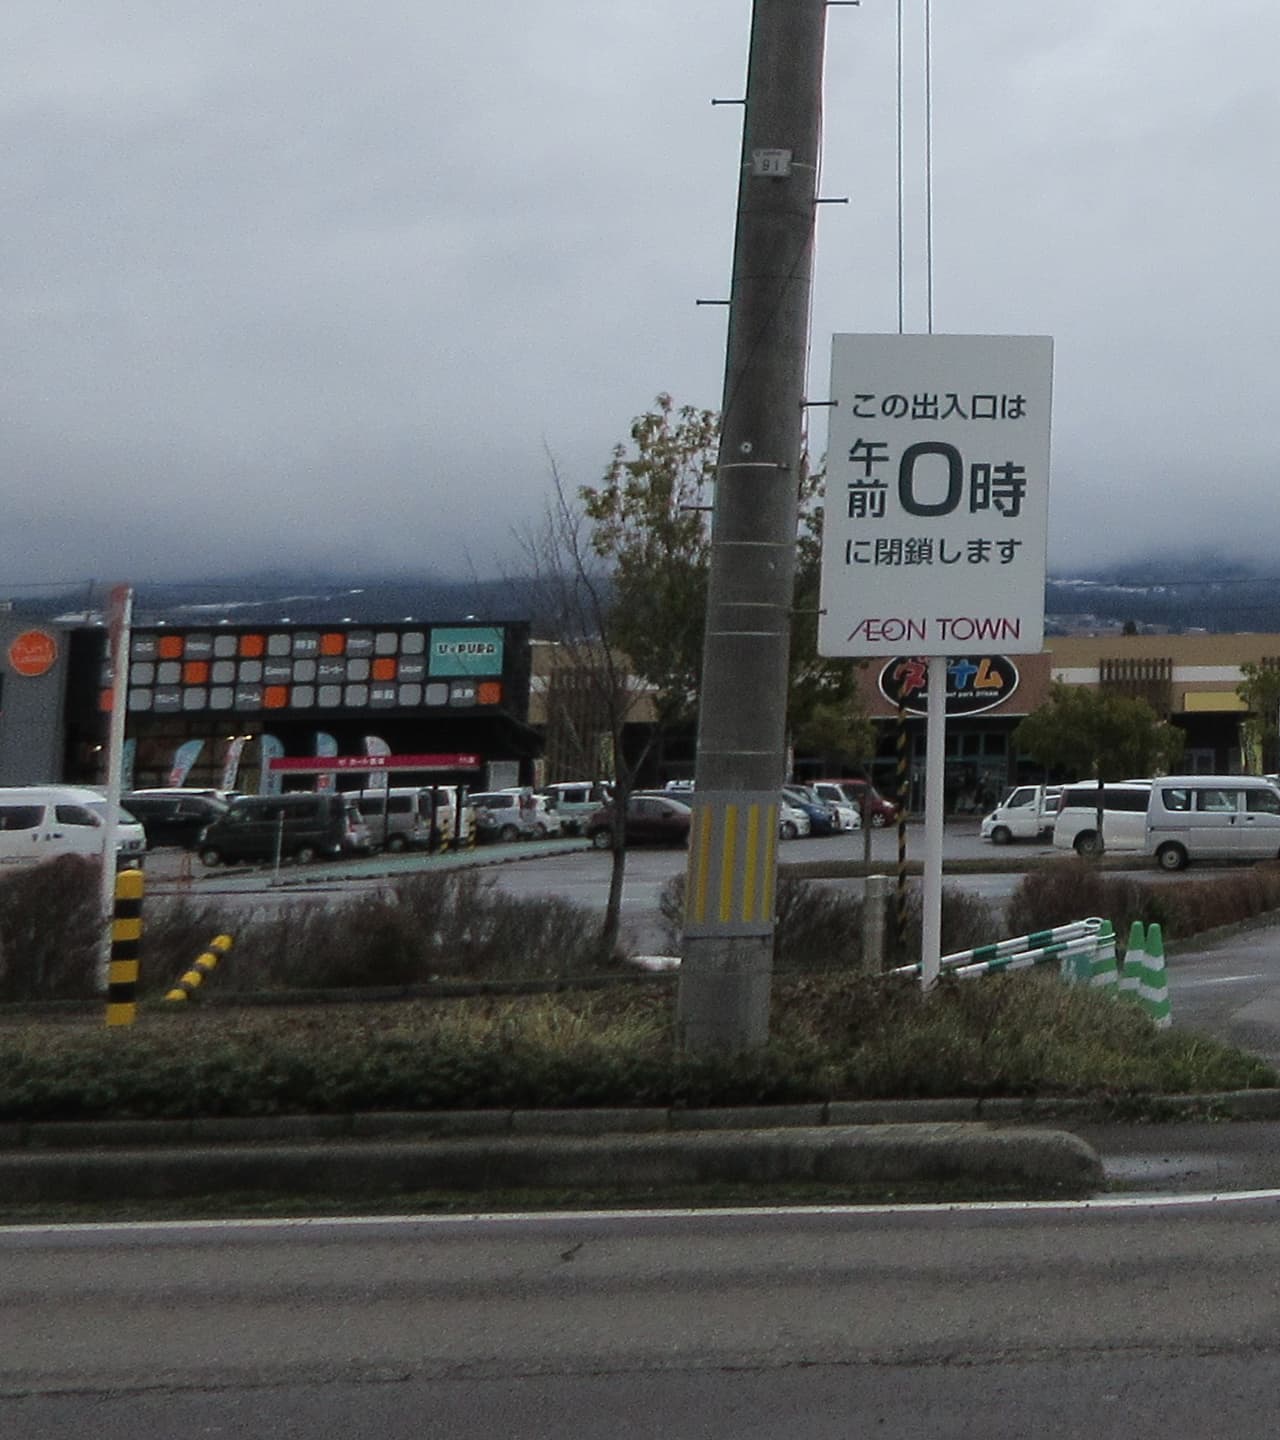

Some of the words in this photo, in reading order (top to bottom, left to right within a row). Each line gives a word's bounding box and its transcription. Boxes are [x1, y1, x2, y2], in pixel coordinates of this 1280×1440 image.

[852, 393, 1027, 420] この出入口は
[846, 537, 1022, 566] に閉鎖します
[936, 617, 1020, 641] TOWN
[893, 656, 1004, 696] ダナム
